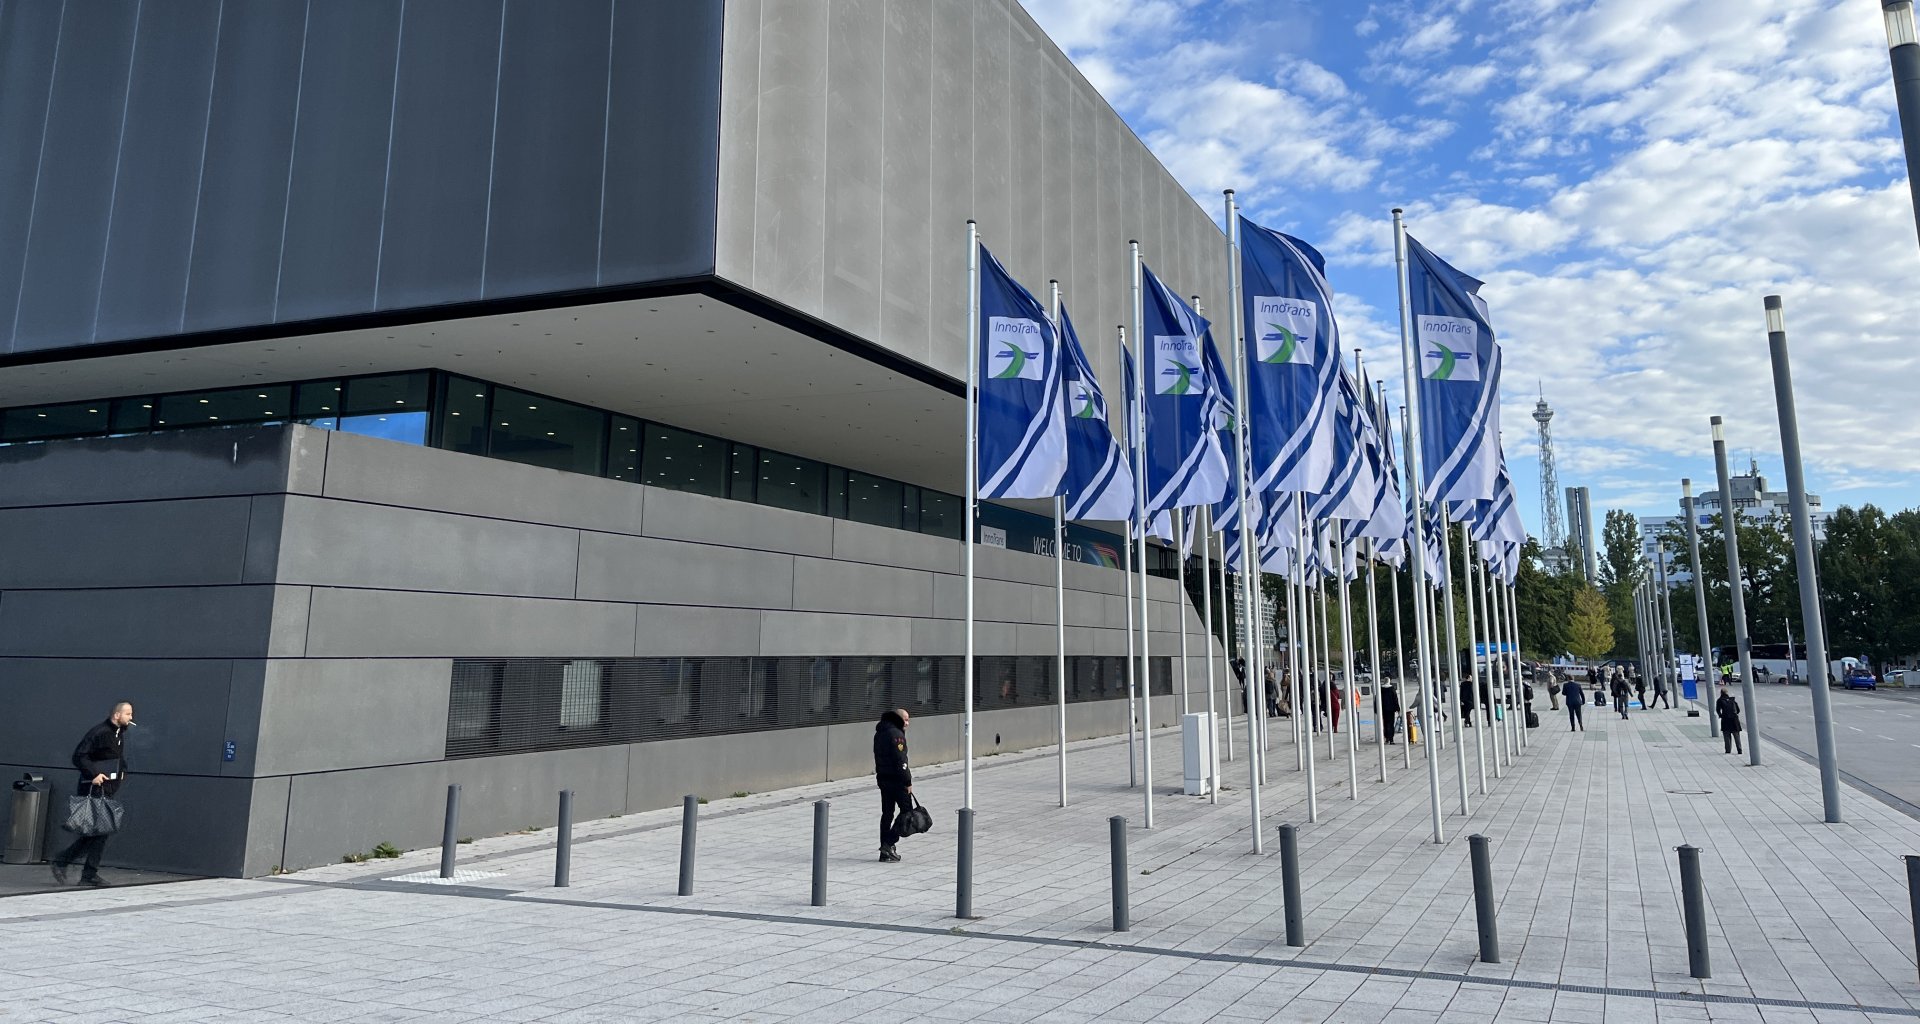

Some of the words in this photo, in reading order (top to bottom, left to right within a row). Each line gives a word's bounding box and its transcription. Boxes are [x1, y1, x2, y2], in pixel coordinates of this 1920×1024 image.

[1260, 301, 1311, 317] InnoTrans
[1423, 320, 1472, 335] InnoTrans
[984, 531, 1004, 546] InnoTrans
[1072, 544, 1082, 562] TO
